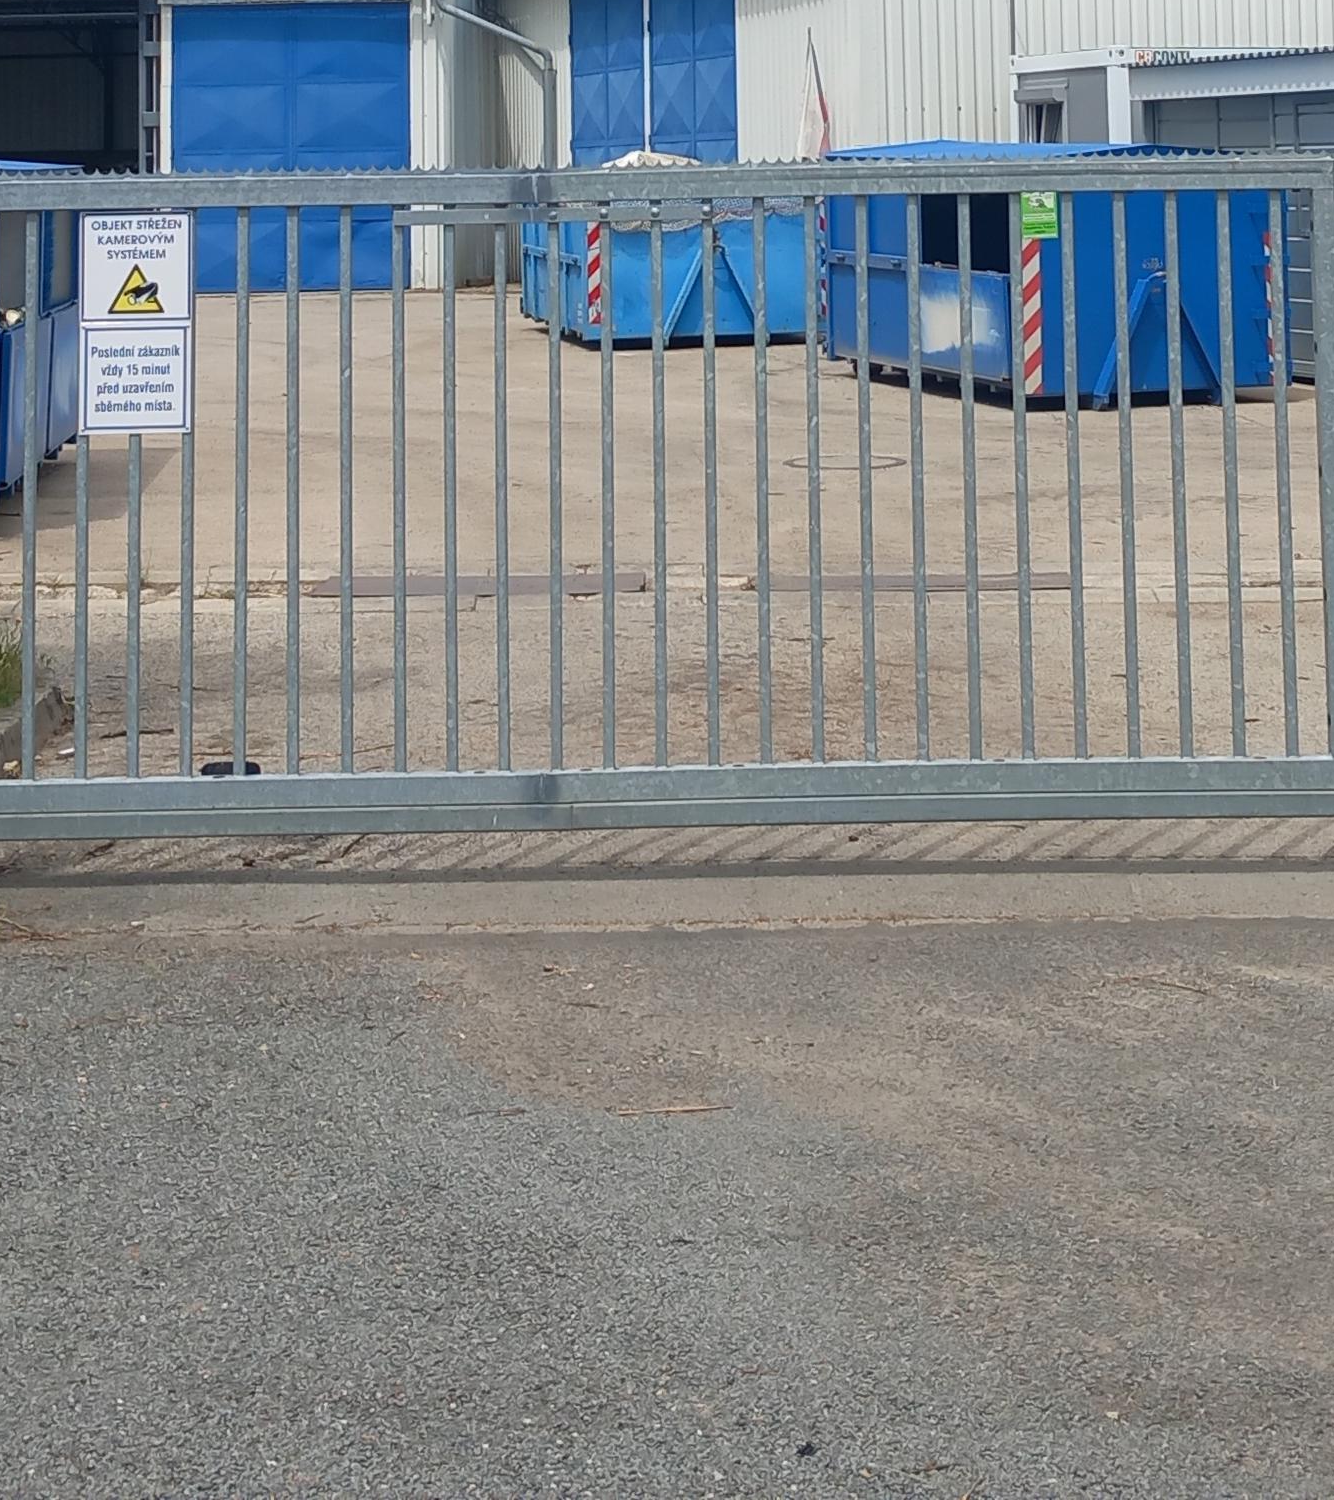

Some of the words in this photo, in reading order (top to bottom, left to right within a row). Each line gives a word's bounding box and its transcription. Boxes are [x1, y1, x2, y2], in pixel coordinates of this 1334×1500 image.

[91, 220, 133, 231] OBJEKT
[136, 218, 182, 230] STŘEŽEN
[97, 232, 175, 246] KAMEROVÝM
[107, 246, 167, 260] SYSTÉMEM
[91, 345, 135, 358] Poslední
[137, 344, 180, 358] zákazník
[101, 364, 123, 378] vždy
[127, 364, 139, 375] 15
[142, 363, 171, 375] minut
[97, 382, 119, 397] před
[122, 381, 174, 394] uzavřením
[95, 400, 142, 412] sběrného
